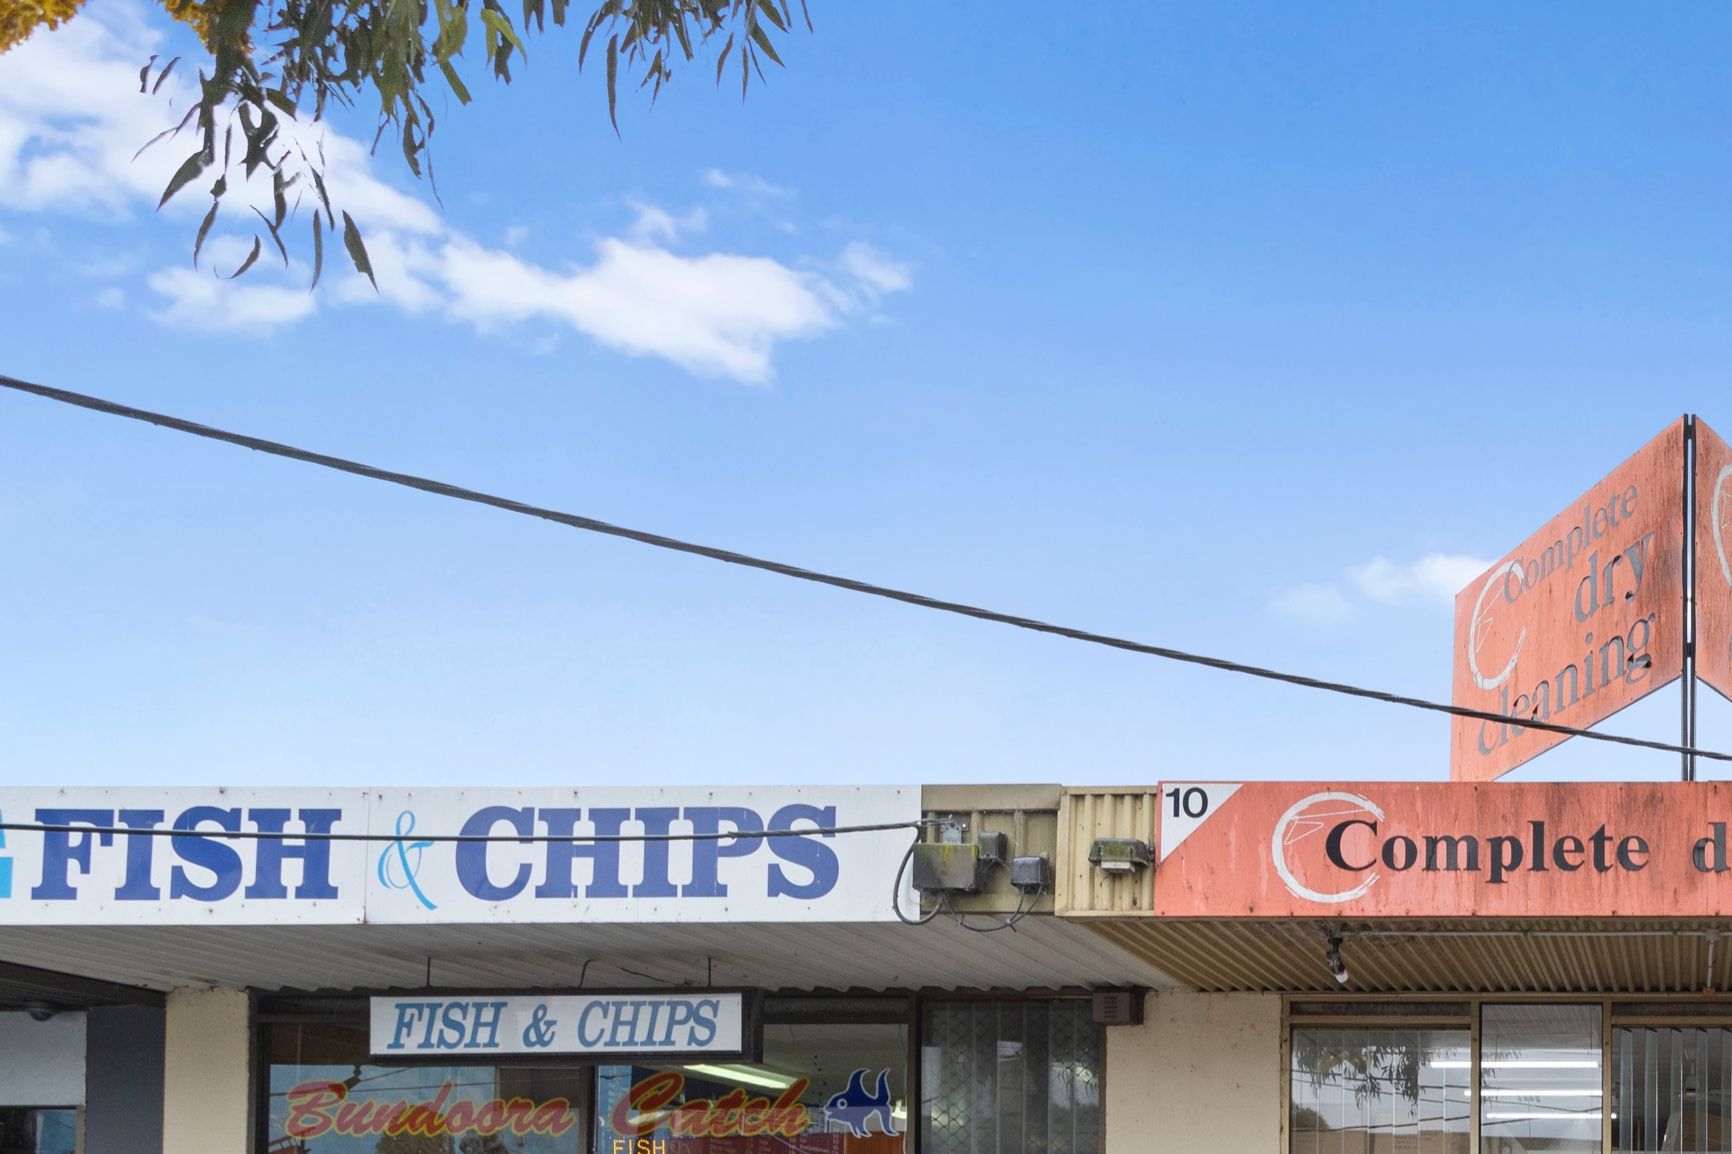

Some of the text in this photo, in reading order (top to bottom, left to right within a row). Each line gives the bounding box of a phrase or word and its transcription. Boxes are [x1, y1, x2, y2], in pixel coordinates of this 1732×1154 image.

[1504, 484, 1638, 604] Complete
[1574, 531, 1655, 624] dry
[1477, 612, 1657, 756] cleaning
[1166, 787, 1208, 818] 10
[31, 803, 839, 910] FISH & CHIPS
[1325, 819, 1649, 884] Complete
[387, 1000, 719, 1049] FISH & CHIPS
[285, 1070, 810, 1139] Bundoora Catch
